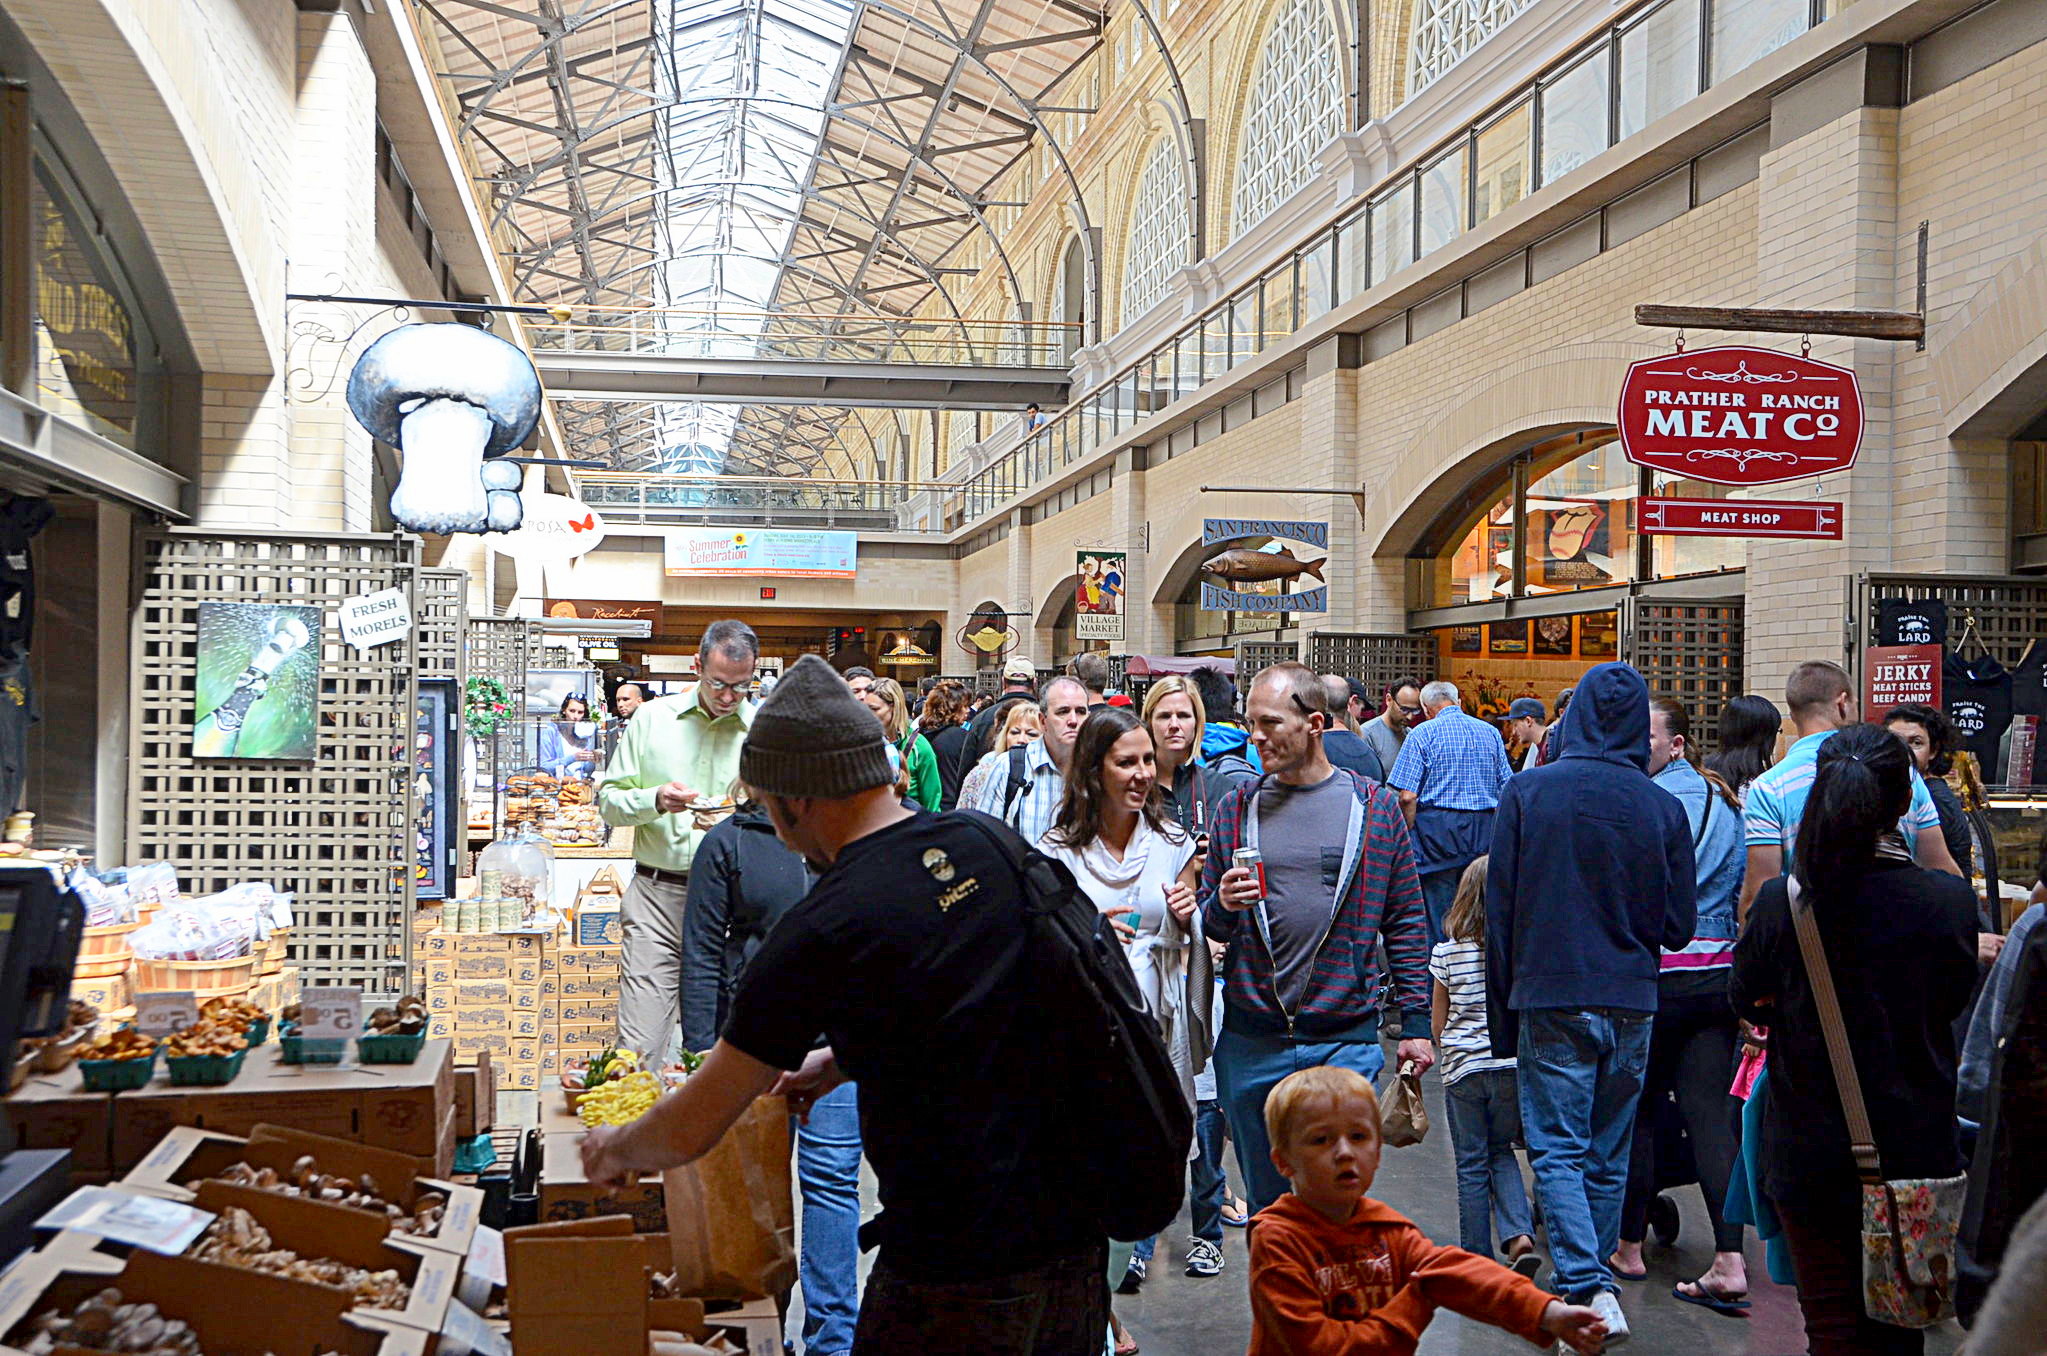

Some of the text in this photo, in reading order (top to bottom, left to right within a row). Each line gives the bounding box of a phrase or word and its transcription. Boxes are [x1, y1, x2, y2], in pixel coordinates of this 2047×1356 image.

[1645, 390, 1840, 410] PRATHER RANCH
[1644, 409, 1774, 440] MEAT
[1701, 511, 1781, 525] MEAT SHOP
[1205, 521, 1326, 546] SAN FRANCISCO
[688, 539, 732, 552] Summer
[690, 549, 747, 564] Celebration
[1205, 585, 1326, 610] FISH COMPANY
[352, 598, 398, 617] FRESH
[350, 615, 407, 638] MORELS
[1080, 615, 1121, 624] VILLAGE
[1080, 624, 1120, 633] MARKET
[1898, 632, 1931, 644] LARD
[1873, 664, 1932, 682] JERKY
[1873, 682, 1932, 692] MEAT STICKS
[1873, 693, 1932, 703] BEEF CANDY
[1951, 717, 1984, 730] LARD
